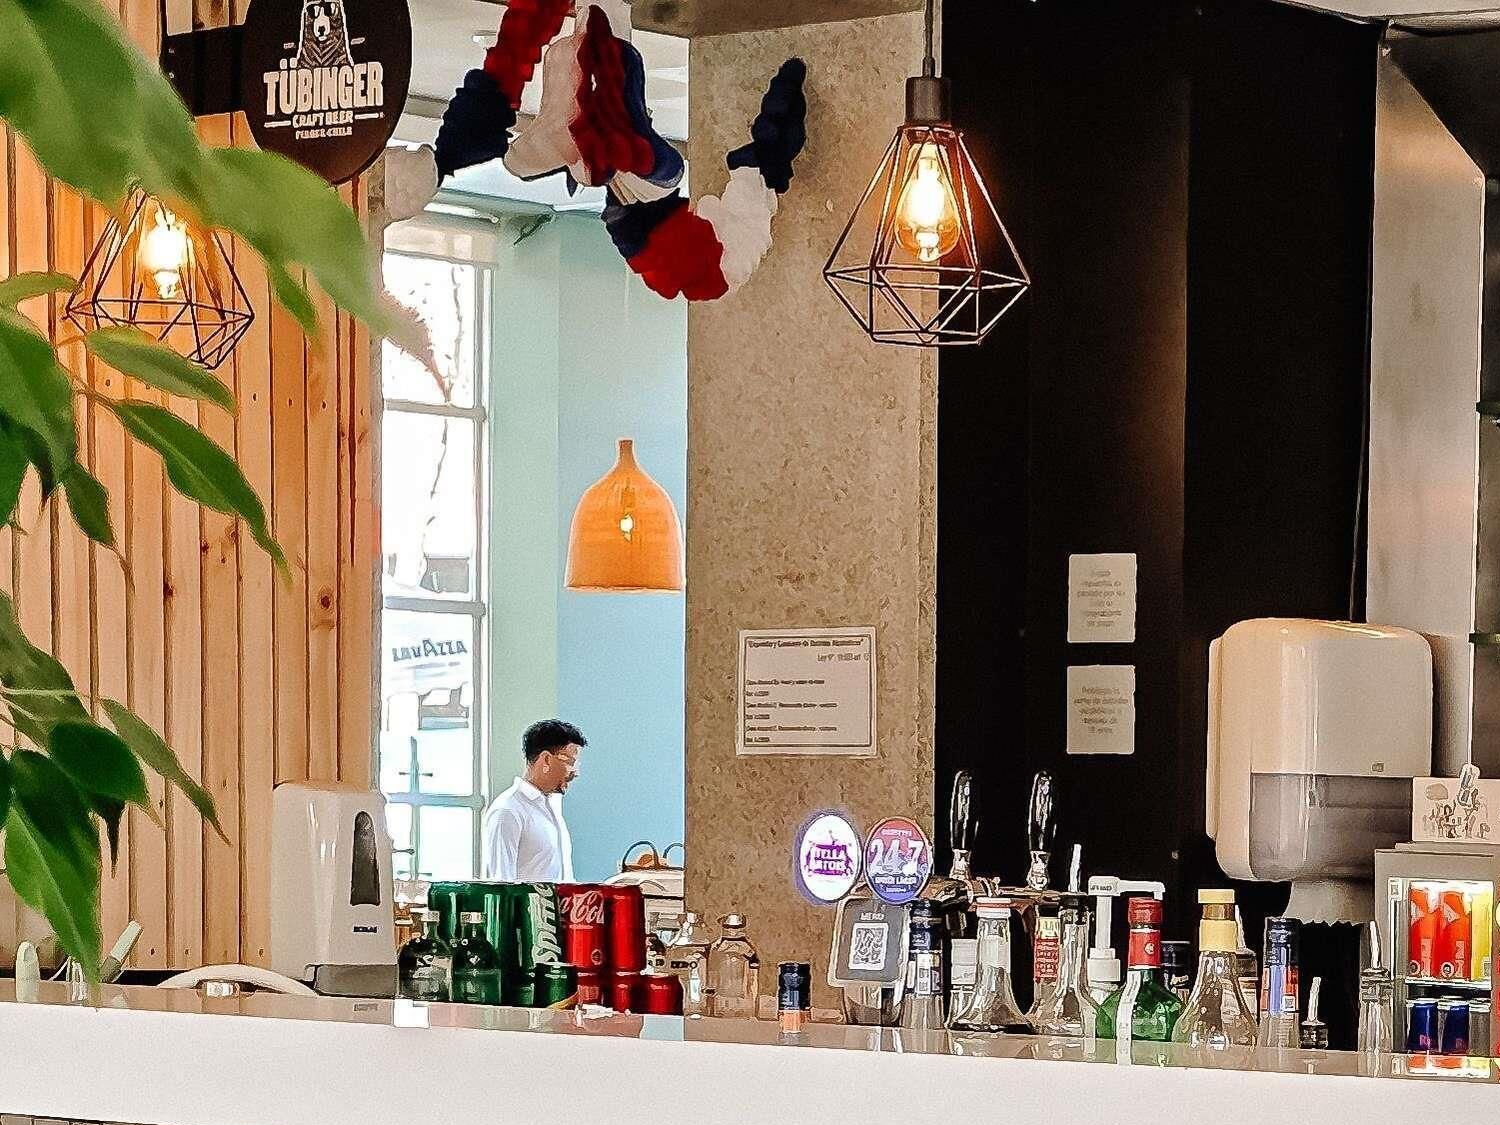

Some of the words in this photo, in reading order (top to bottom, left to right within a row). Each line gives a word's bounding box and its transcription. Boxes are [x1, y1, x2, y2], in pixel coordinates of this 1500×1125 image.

[263, 58, 384, 115] TÜBINGER
[292, 112, 324, 128] CRAFT
[325, 110, 354, 126] BEER
[391, 639, 468, 662] LAVAZZA
